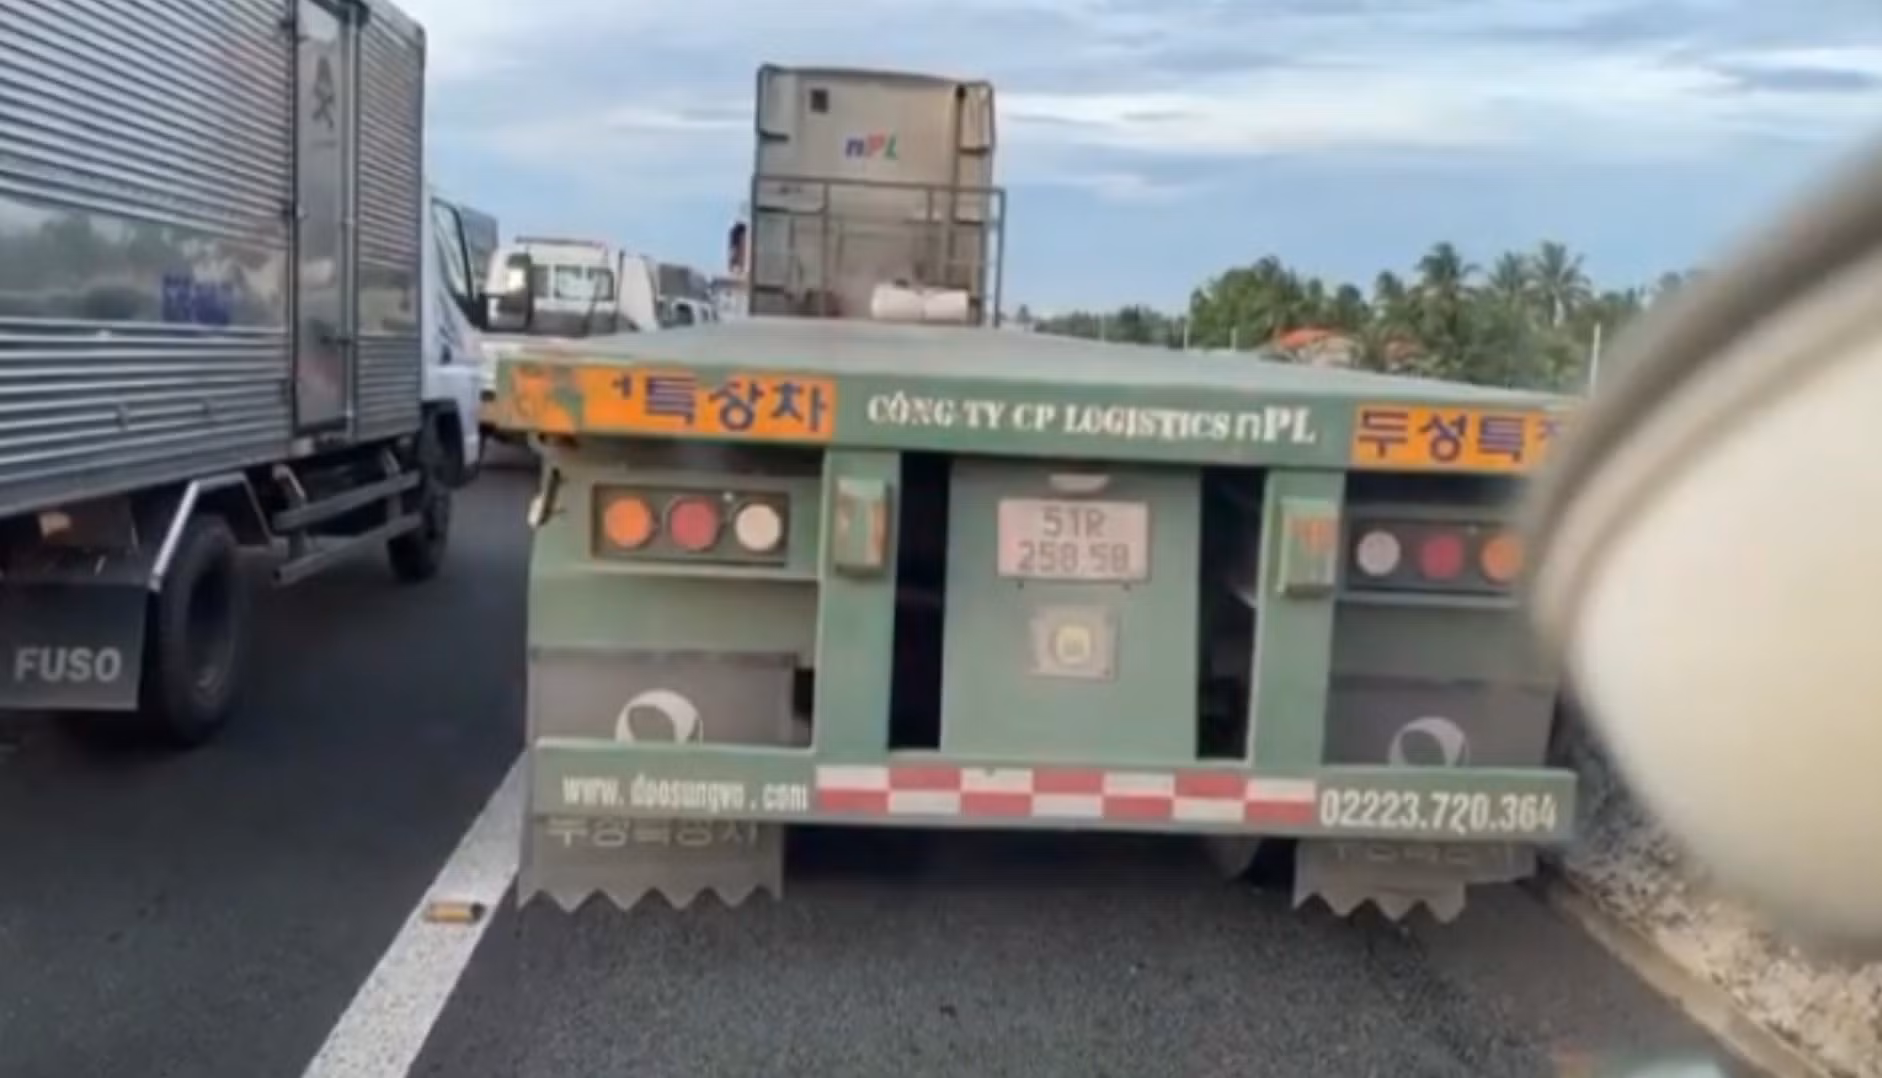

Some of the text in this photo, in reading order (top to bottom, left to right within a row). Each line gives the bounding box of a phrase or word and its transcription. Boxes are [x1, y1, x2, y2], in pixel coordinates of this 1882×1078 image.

[845, 132, 898, 159] nPL
[867, 390, 954, 428] CÔNG
[962, 398, 1006, 430] TY
[1012, 401, 1056, 432] CP
[1063, 403, 1229, 441] LOGISTICS
[1041, 504, 1105, 538] 51R
[14, 645, 122, 682] FUSO
[1319, 787, 1556, 835] 02223.720.364
